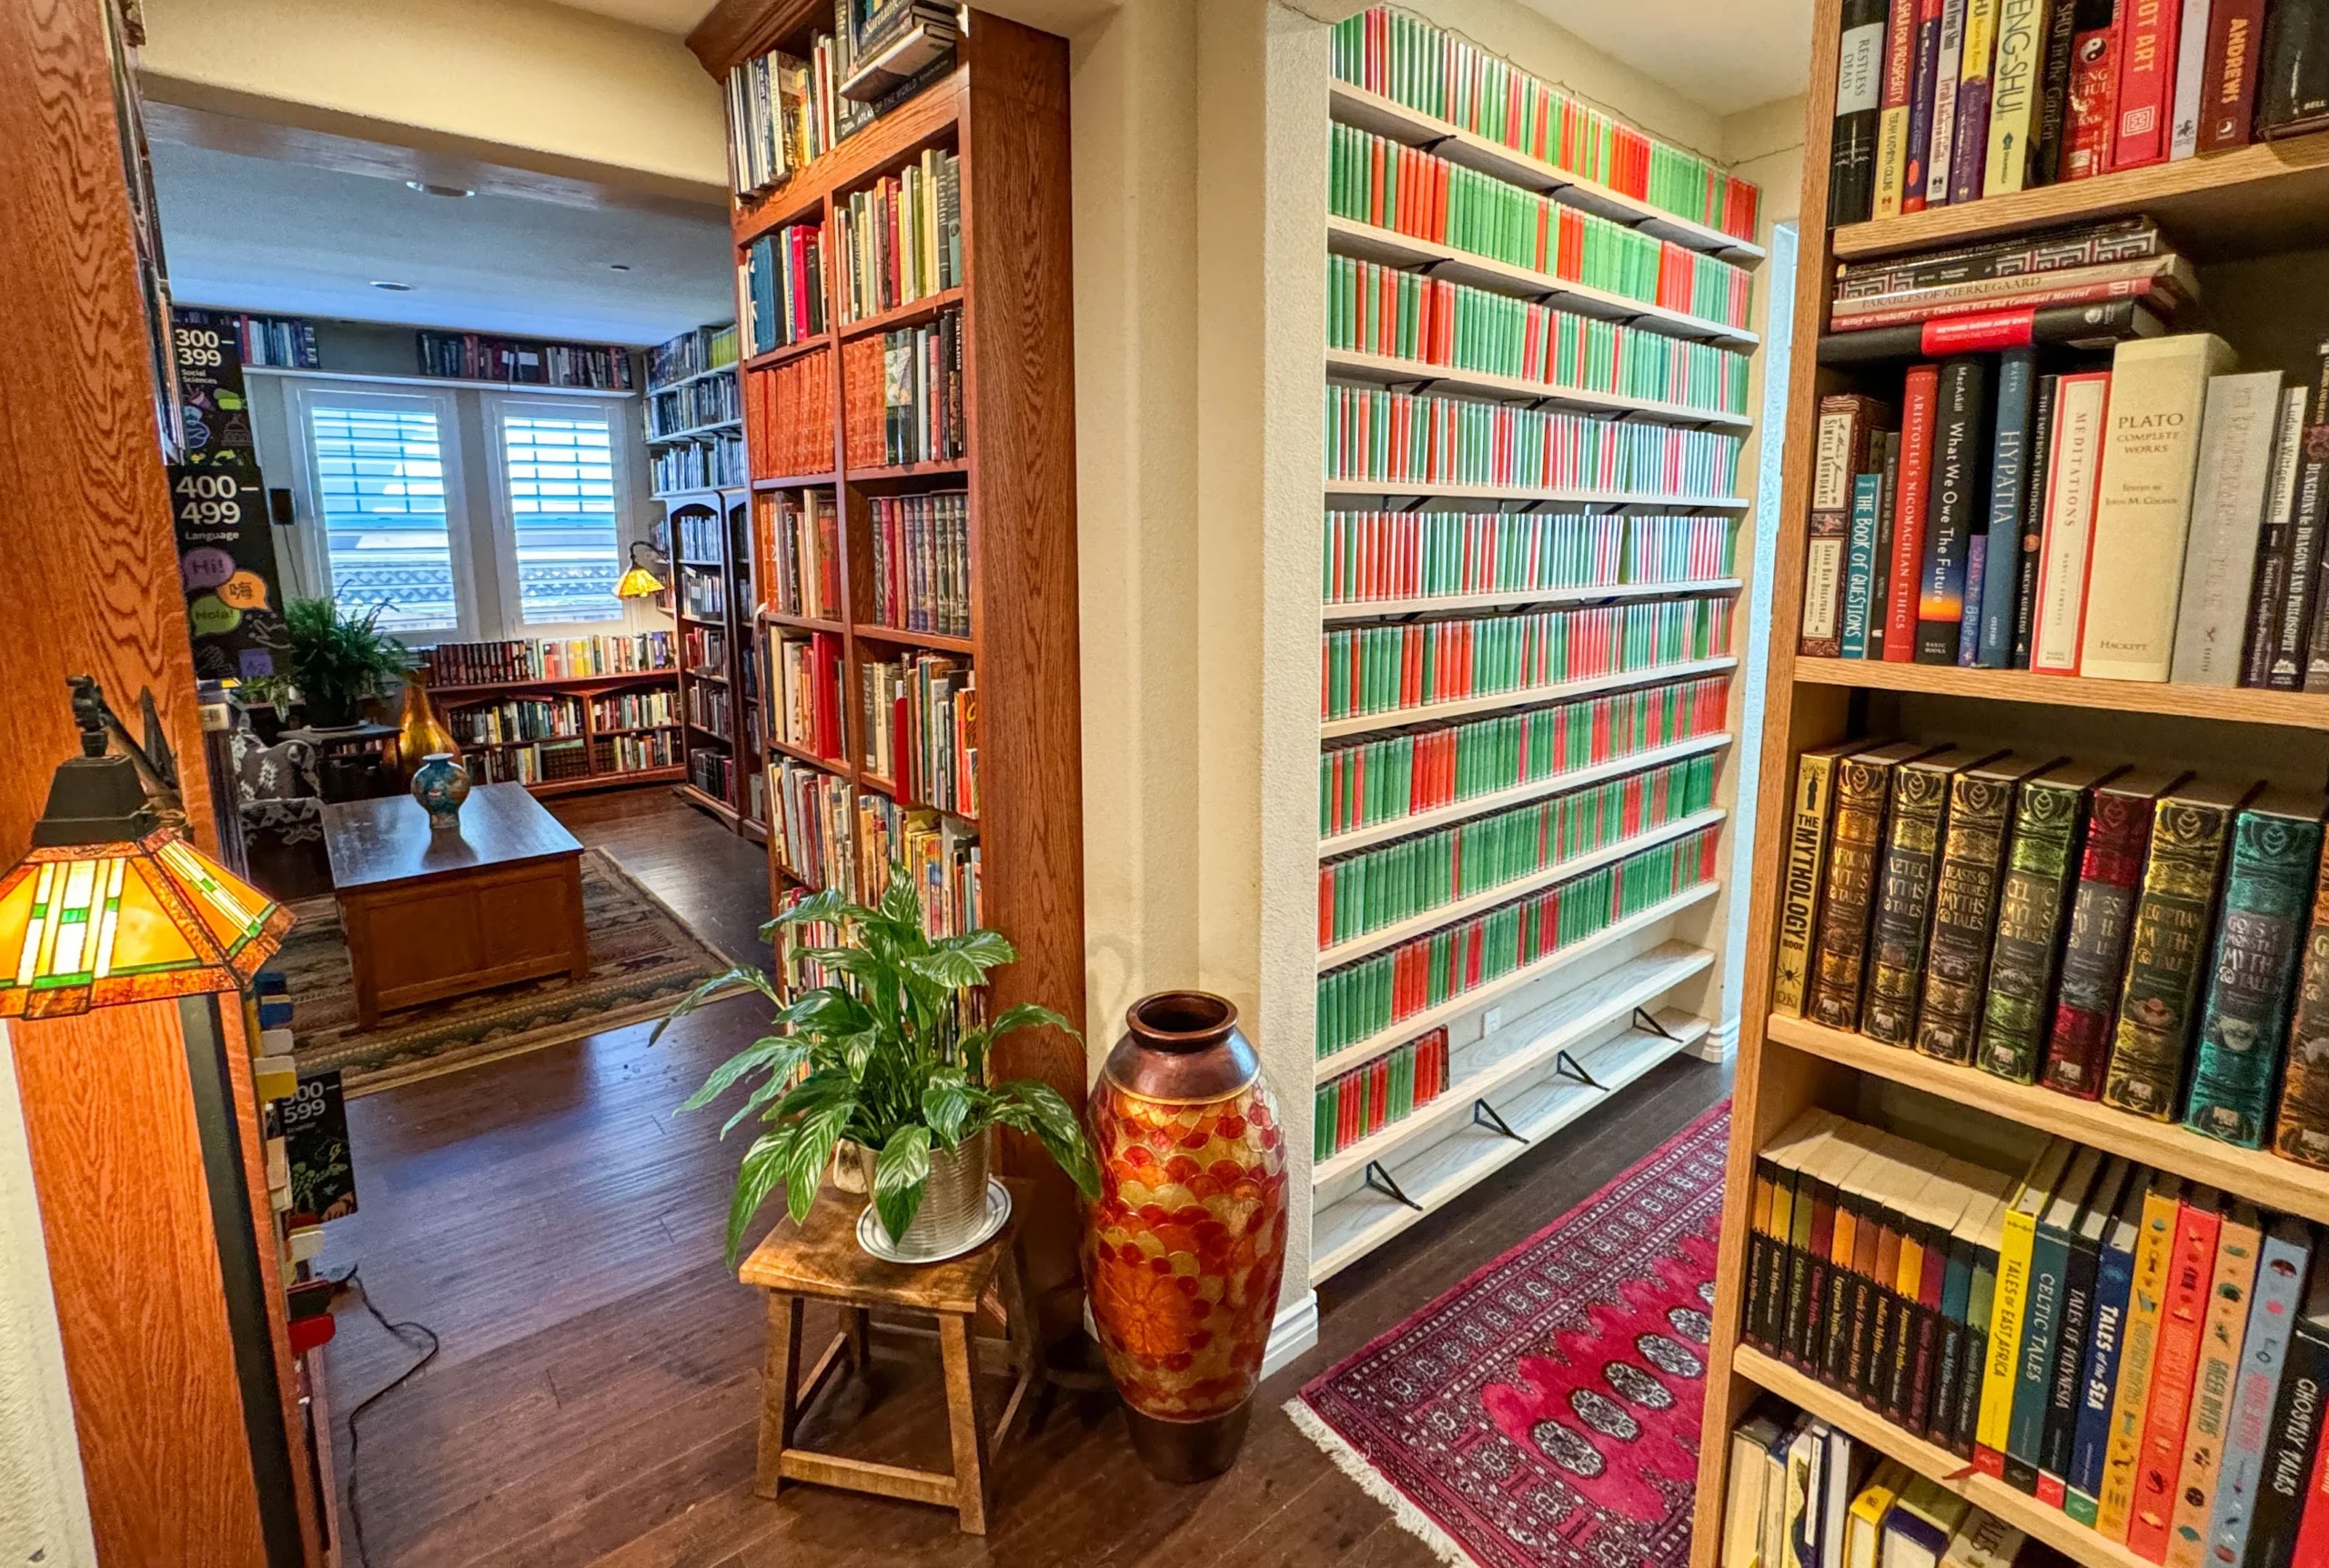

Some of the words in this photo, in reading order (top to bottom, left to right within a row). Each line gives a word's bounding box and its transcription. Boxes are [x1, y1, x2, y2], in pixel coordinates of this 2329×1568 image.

[1897, 1, 1912, 26] SHUI
[1895, 25, 1908, 46] FOR
[1943, 29, 1957, 51] Shui
[1854, 37, 1869, 96] RESTLESS
[2131, 30, 2155, 75] ART
[2221, 18, 2249, 104] ANDREWS
[1840, 53, 1854, 90] DEAD
[1890, 45, 1907, 103] PROSPERITY
[1938, 74, 1954, 103] Terah
[857, 108, 874, 125] ATLAS
[2041, 85, 2061, 141] Garden
[1882, 166, 1893, 192] COLLINS
[1862, 292, 1922, 308] PARABLES
[1924, 291, 1941, 300] OF
[1944, 276, 2042, 297] KIERKEGAARD
[178, 348, 222, 367] 399
[1953, 366, 1966, 411] MacAskill
[2008, 360, 2019, 393] WATTS
[2038, 395, 2047, 414] THE
[1822, 418, 1835, 452] SIMPLE
[1908, 394, 1923, 476] ARISTOTLE'S
[2118, 412, 2183, 429] PLATO
[2281, 402, 2297, 443] Ludwig
[1946, 420, 1962, 461] What
[2116, 431, 2181, 443] COMPLETE
[2124, 444, 2169, 454] WORKS
[1818, 455, 1832, 505] ABUNDANCE
[1944, 462, 1959, 488] We
[1993, 428, 2020, 526] HYPATIA
[2064, 411, 2086, 528] MEDITATIONS
[2272, 443, 2292, 517] Wittgenstein
[1857, 491, 1872, 513] THE
[2029, 468, 2040, 524] HANDBOOK
[2301, 462, 2321, 515] DUNGEONS
[181, 501, 241, 525] 499
[1941, 490, 1957, 524] Owe
[2299, 514, 2311, 527] &
[185, 531, 240, 542] Language
[1853, 517, 1871, 549] BOOK
[1900, 480, 1915, 577] NICOMACHEAN
[1938, 526, 1952, 554] The
[2292, 526, 2311, 573] DRAGONS
[191, 558, 225, 575] Hi!
[1932, 558, 1950, 605] Future
[2021, 561, 2031, 594] MARCUS
[228, 580, 255, 601] 嗨
[2289, 571, 2304, 594] AND
[195, 608, 235, 621] Hola!
[1845, 573, 1867, 638] QUESTIONS
[1895, 582, 1907, 629] ETHICS
[2018, 594, 2027, 633] AURELIUS
[1989, 616, 1997, 646] OXFORD
[2280, 592, 2302, 652] PHILOSOPHY
[1798, 813, 1820, 829] THE
[1783, 827, 1819, 941] MYTHOLOGY
[1943, 879, 1989, 898] CREATURES
[1946, 864, 1977, 882] BEASTS
[1941, 892, 1986, 915] MYTHS
[1952, 912, 1983, 930] TALES
[1782, 939, 1805, 951] BOOK
[284, 1099, 326, 1124] 599
[1768, 1271, 1780, 1294] Myths
[1794, 1257, 1803, 1280] Celtic
[2004, 1259, 2021, 1297] TALES
[1790, 1282, 1800, 1307] Myths
[1830, 1275, 1844, 1311] Egyptian
[1856, 1284, 1867, 1310] Greek
[2033, 1272, 2055, 1331] CELTIC
[2067, 1288, 2085, 1327] TALES
[1829, 1312, 1840, 1335] Myths
[1876, 1295, 1889, 1325] Indian
[1896, 1307, 1911, 1344] Japanese
[1999, 1308, 2018, 1338] EAST
[1851, 1320, 1863, 1351] Roman
[1870, 1326, 1883, 1353] Myths
[2064, 1326, 2079, 1345] OF
[2096, 1303, 2119, 1352] TALES
[1847, 1351, 1860, 1377] Myths
[1894, 1343, 1907, 1370] Myths
[1993, 1331, 2012, 1378] AFRICA
[2026, 1334, 2048, 1382] TALES
[2094, 1352, 2108, 1366] of
[2055, 1344, 2077, 1410] POLYNESIA
[2094, 1362, 2107, 1380] the
[2086, 1379, 2109, 1411] SEA
[2286, 1377, 2319, 1451] GHOSTLY
[2274, 1448, 2304, 1496] TALES
